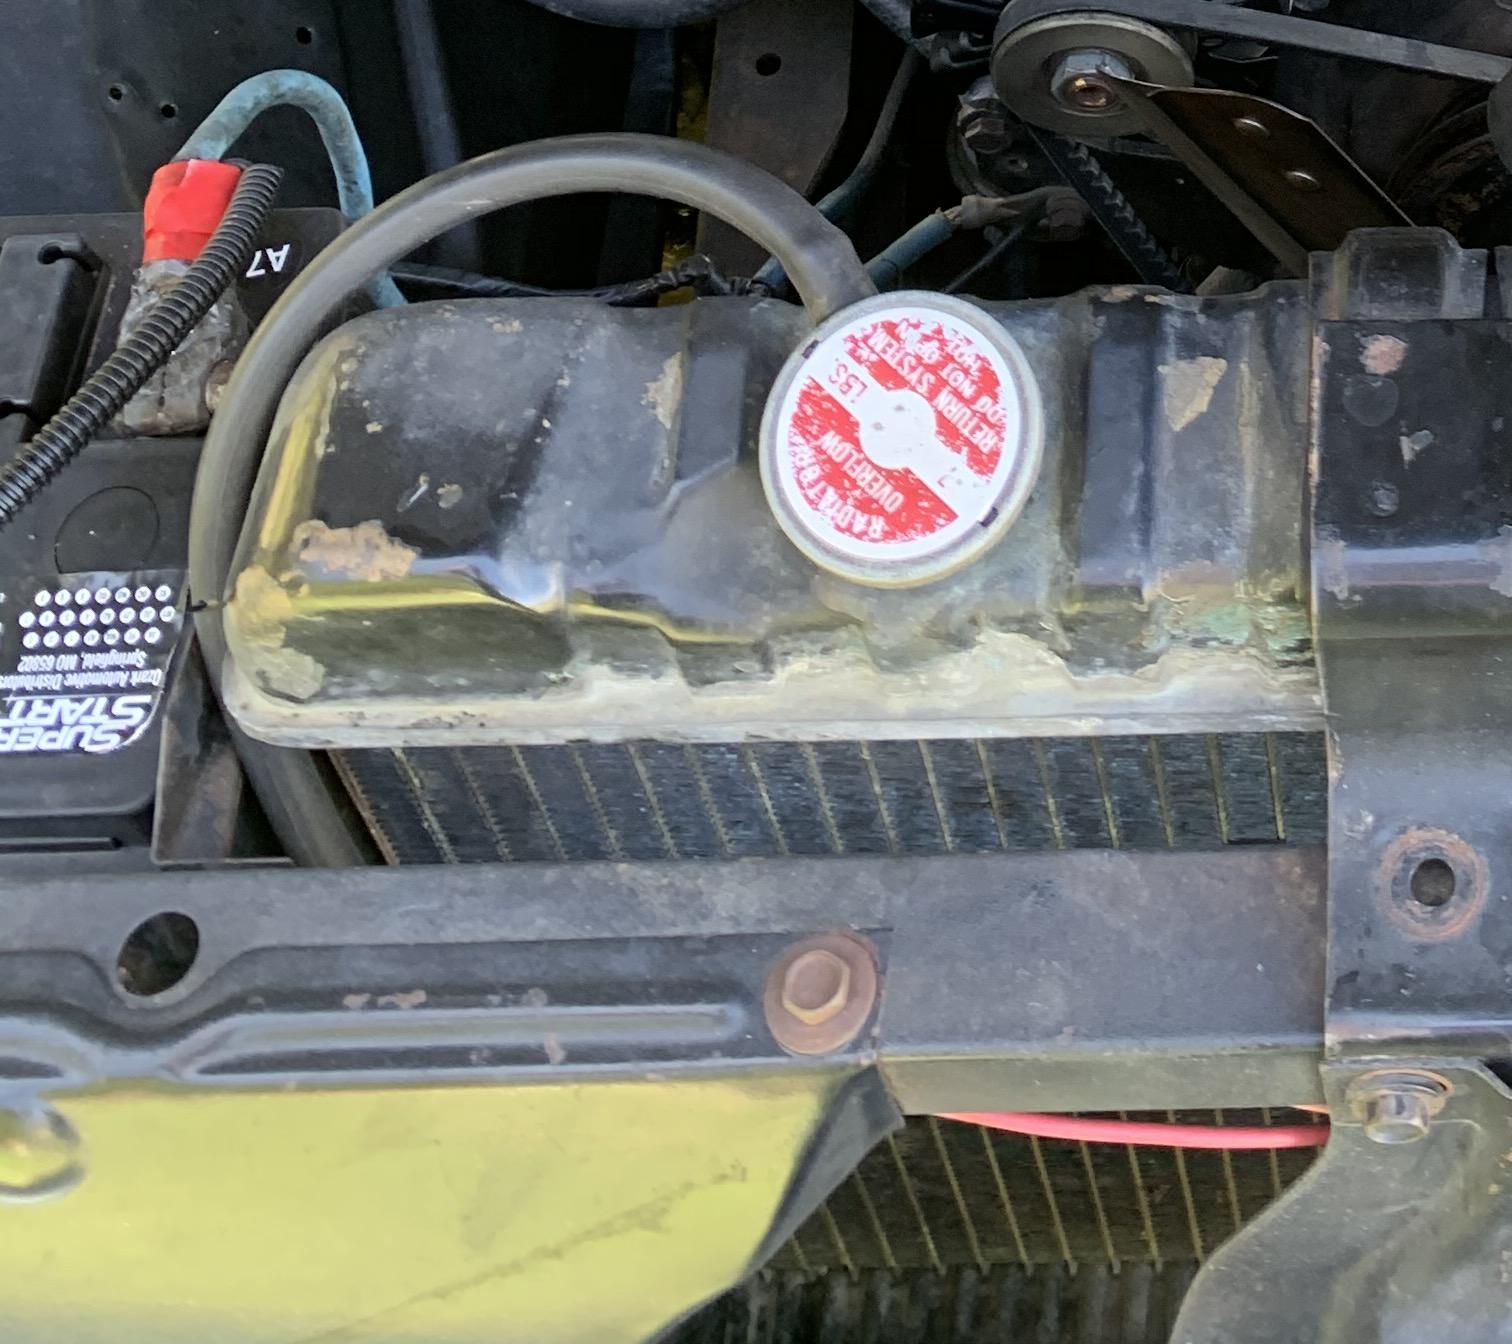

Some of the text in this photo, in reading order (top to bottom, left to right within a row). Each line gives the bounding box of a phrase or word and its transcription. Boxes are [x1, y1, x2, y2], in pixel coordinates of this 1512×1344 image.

[245, 243, 291, 279] A7
[867, 327, 999, 455] RETURN SYSTEM
[819, 429, 906, 514] OVERFLOW
[56, 654, 78, 671] MO
[129, 668, 163, 686] Ozark
[64, 670, 129, 689] Automotive
[5, 694, 152, 726] START
